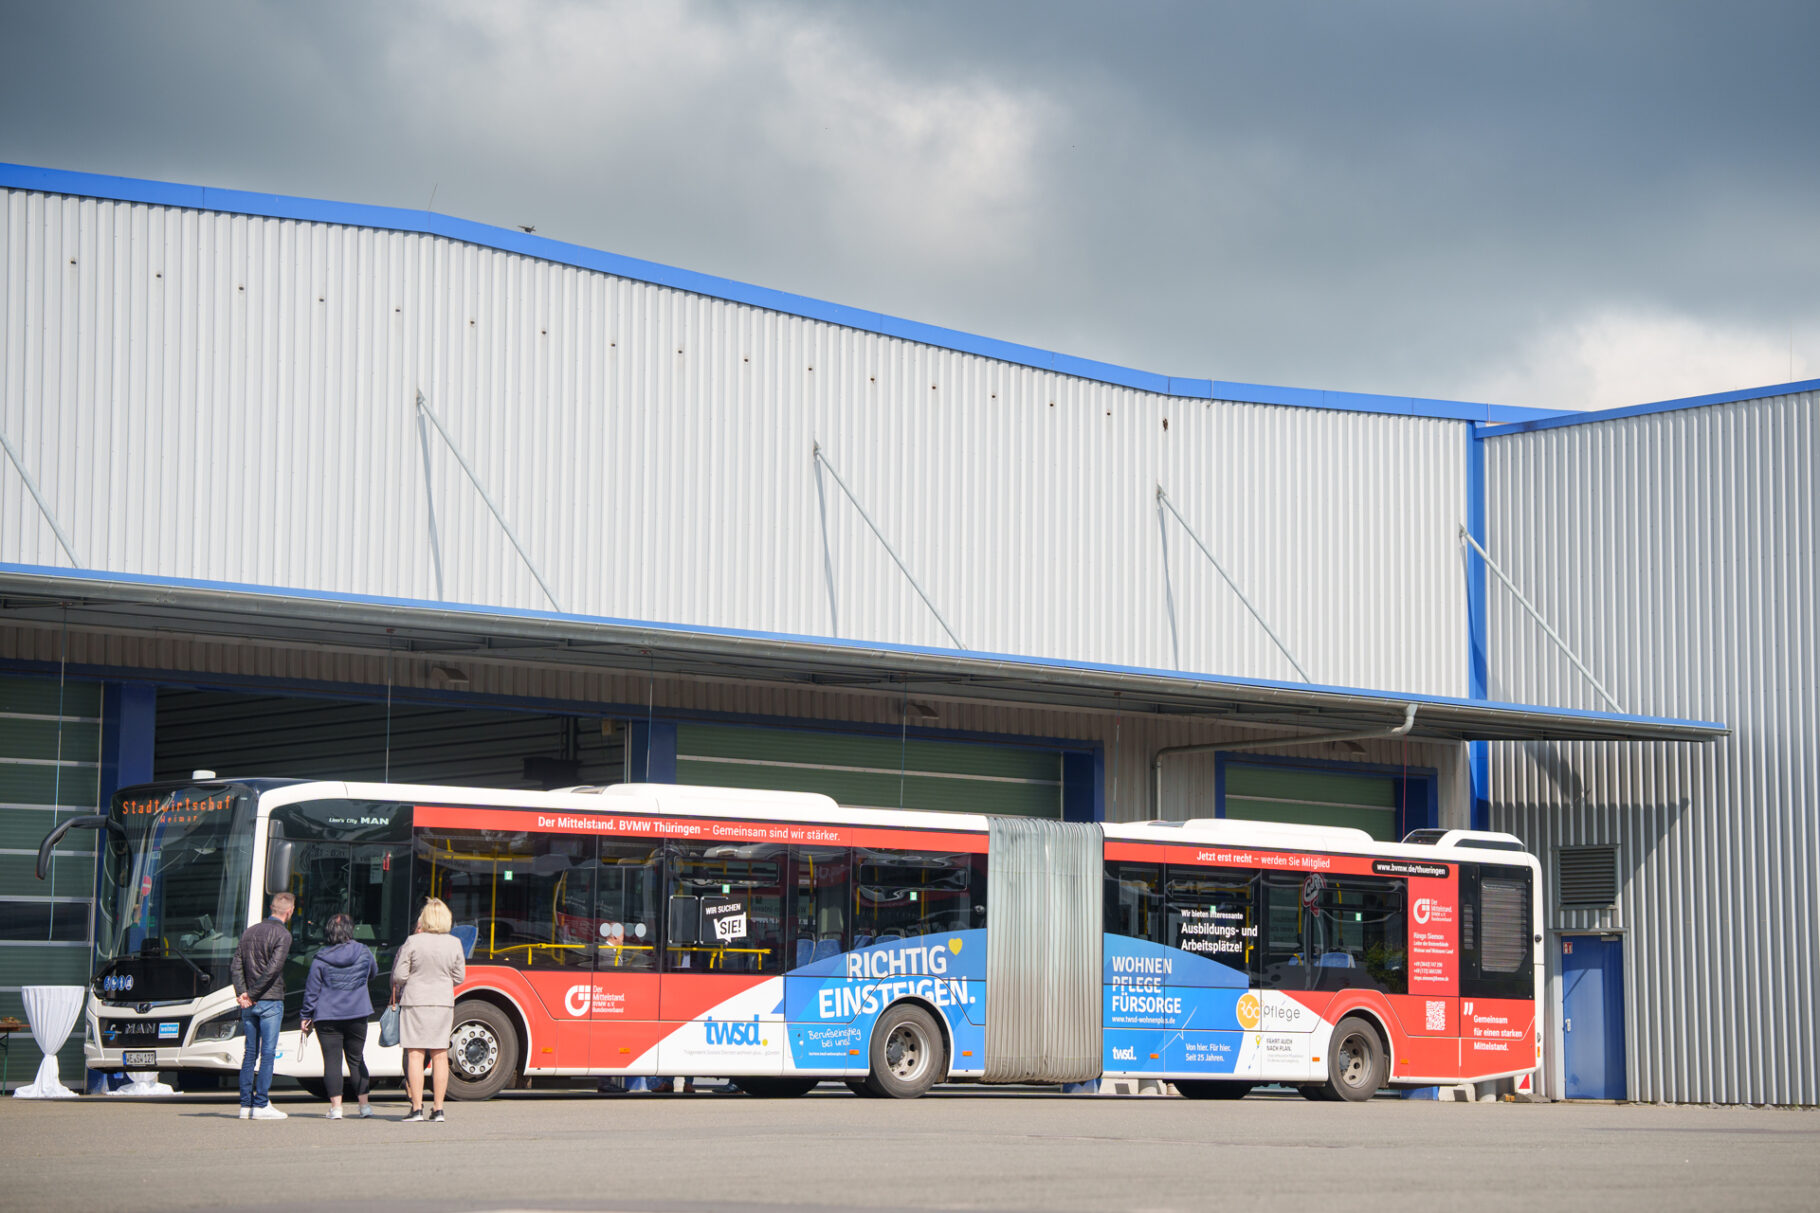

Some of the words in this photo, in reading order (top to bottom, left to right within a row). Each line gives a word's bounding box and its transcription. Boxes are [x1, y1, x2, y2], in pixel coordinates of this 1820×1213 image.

[360, 817, 389, 825] MAN
[538, 816, 554, 827] Der
[558, 817, 616, 830] Mittelstand.
[619, 820, 650, 832] BVMW
[654, 822, 700, 836] Thüringen
[713, 824, 766, 838] Gemeinsam
[769, 828, 788, 839] sind
[791, 829, 804, 840] wir
[807, 830, 840, 841] stärker.
[1197, 852, 1215, 861] Jetzt
[1218, 853, 1232, 862] erst
[1234, 853, 1252, 863] recht
[1261, 856, 1286, 865] werden
[1289, 856, 1300, 866] Sie
[1302, 858, 1330, 869] Mitglied
[1377, 864, 1445, 876] www.bvmw.de/thueringen
[706, 906, 717, 915] WIR
[718, 903, 741, 913] SUCHEN
[1210, 911, 1243, 920] interessante
[720, 920, 741, 934] SIE!
[1181, 922, 1239, 937] Ausbildungs-
[1242, 925, 1258, 936] und
[1181, 939, 1242, 954] Arbeitsplätze!
[846, 945, 947, 983] RICHTIG
[1112, 956, 1172, 974] WOHNEN
[1112, 976, 1161, 994] PFLEGE
[1112, 992, 1181, 1014] FÜRSORGE
[1474, 1015, 1508, 1024] Gemeinsam
[125, 1023, 156, 1034] MAN
[704, 1014, 768, 1046] twsd.
[808, 1028, 862, 1040] Berufseinstieg
[1474, 1028, 1482, 1036] für
[1501, 1029, 1522, 1037] starken
[822, 1040, 833, 1048] bei
[1186, 1043, 1196, 1051] Von
[1474, 1042, 1509, 1051] Mittelstand.
[1112, 1046, 1136, 1060] twsd.
